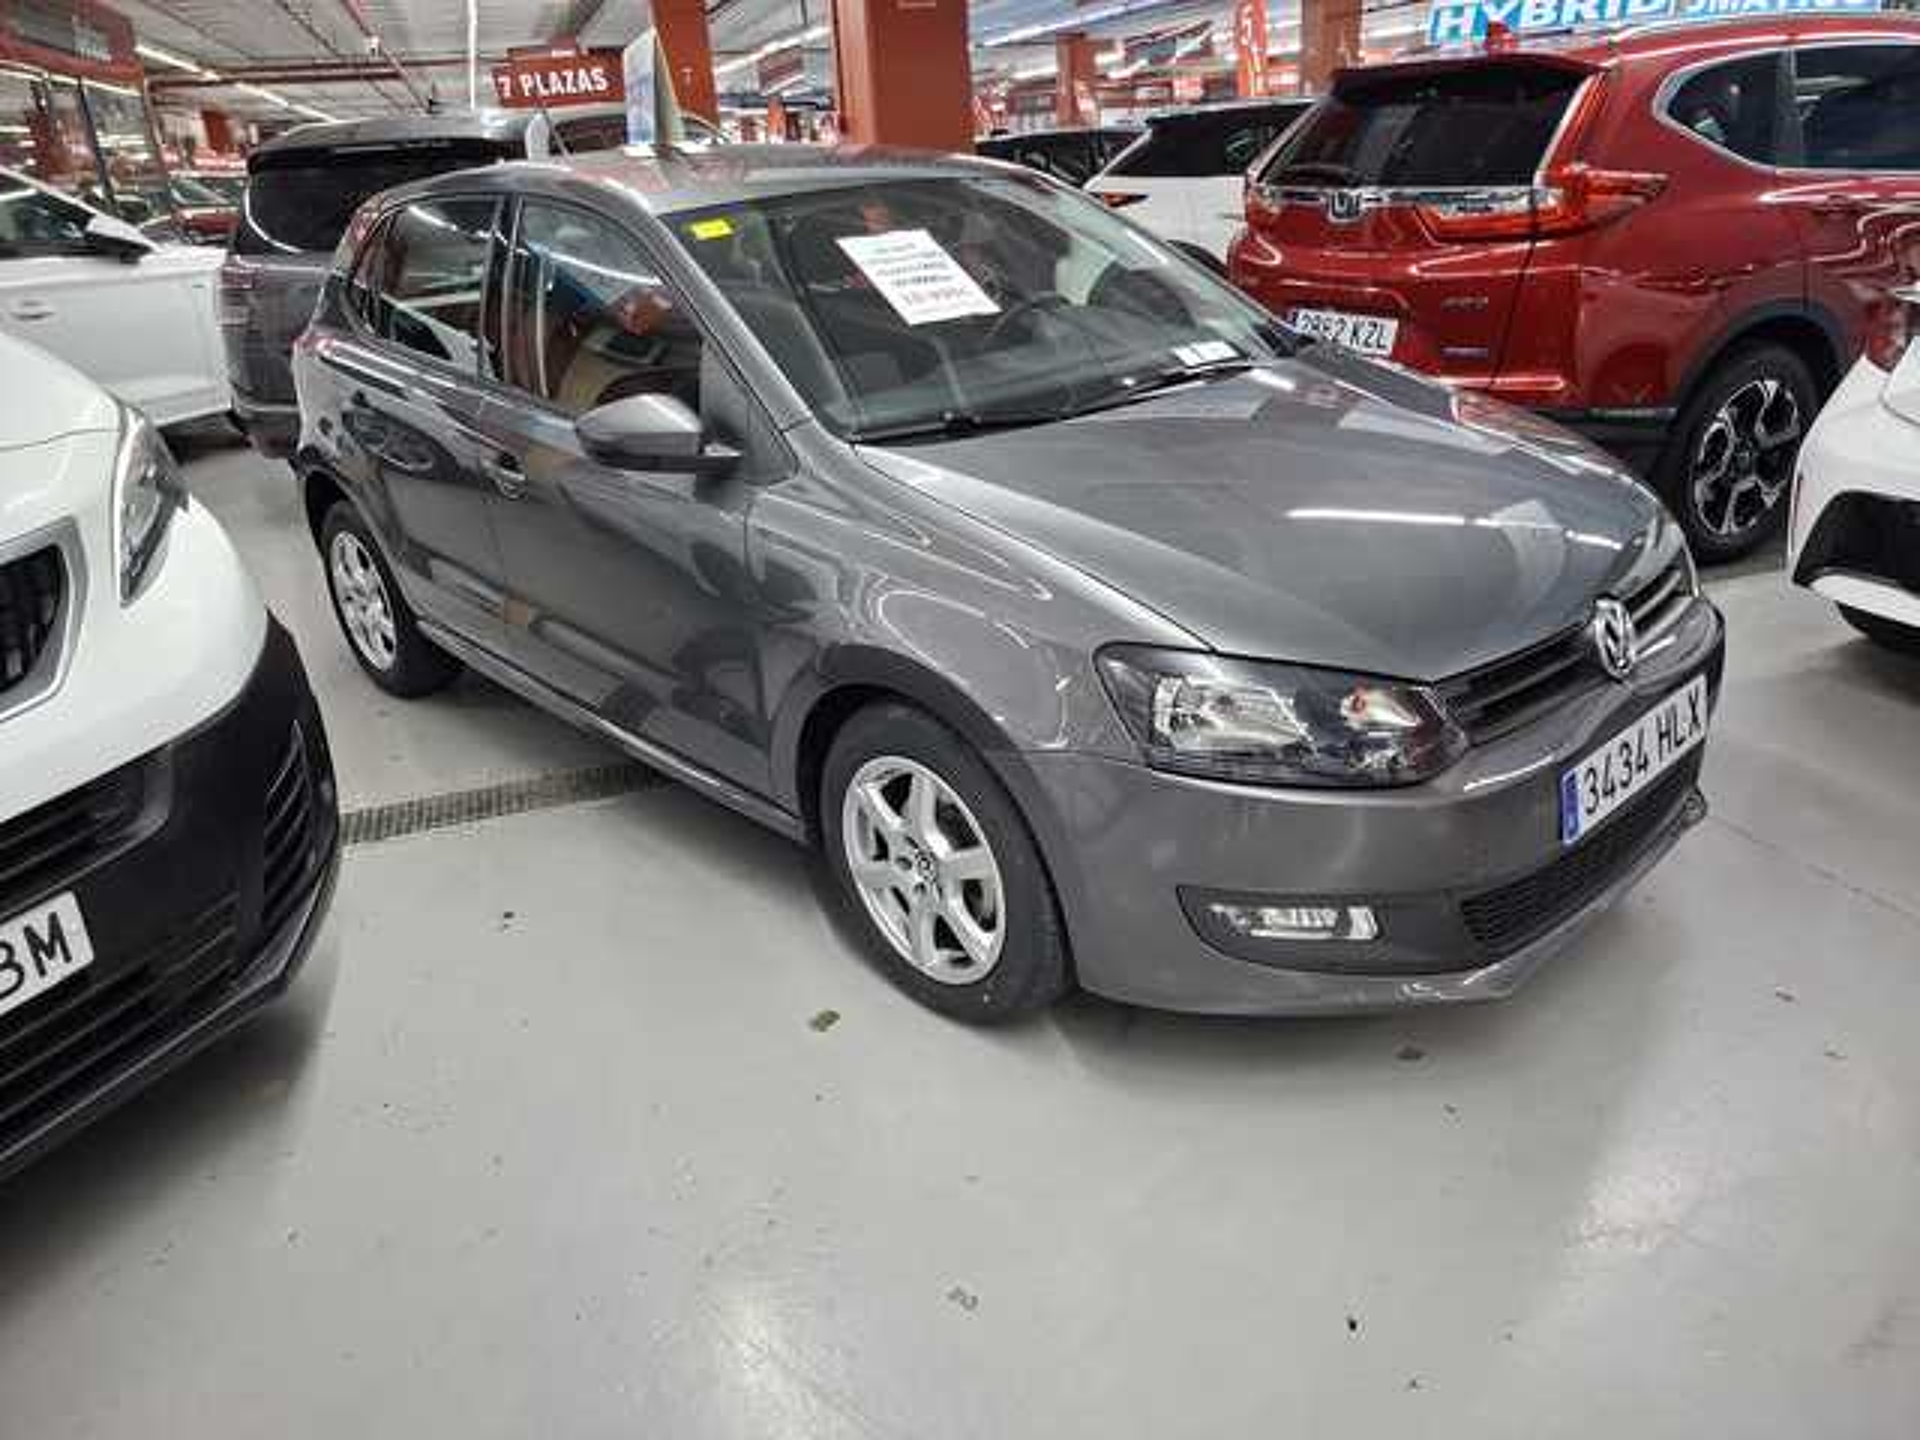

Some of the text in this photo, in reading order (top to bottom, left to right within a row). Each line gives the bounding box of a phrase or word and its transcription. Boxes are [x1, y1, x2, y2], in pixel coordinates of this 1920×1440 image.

[519, 68, 608, 97] PLAZAS
[1584, 685, 1701, 816] 3434 HLX
